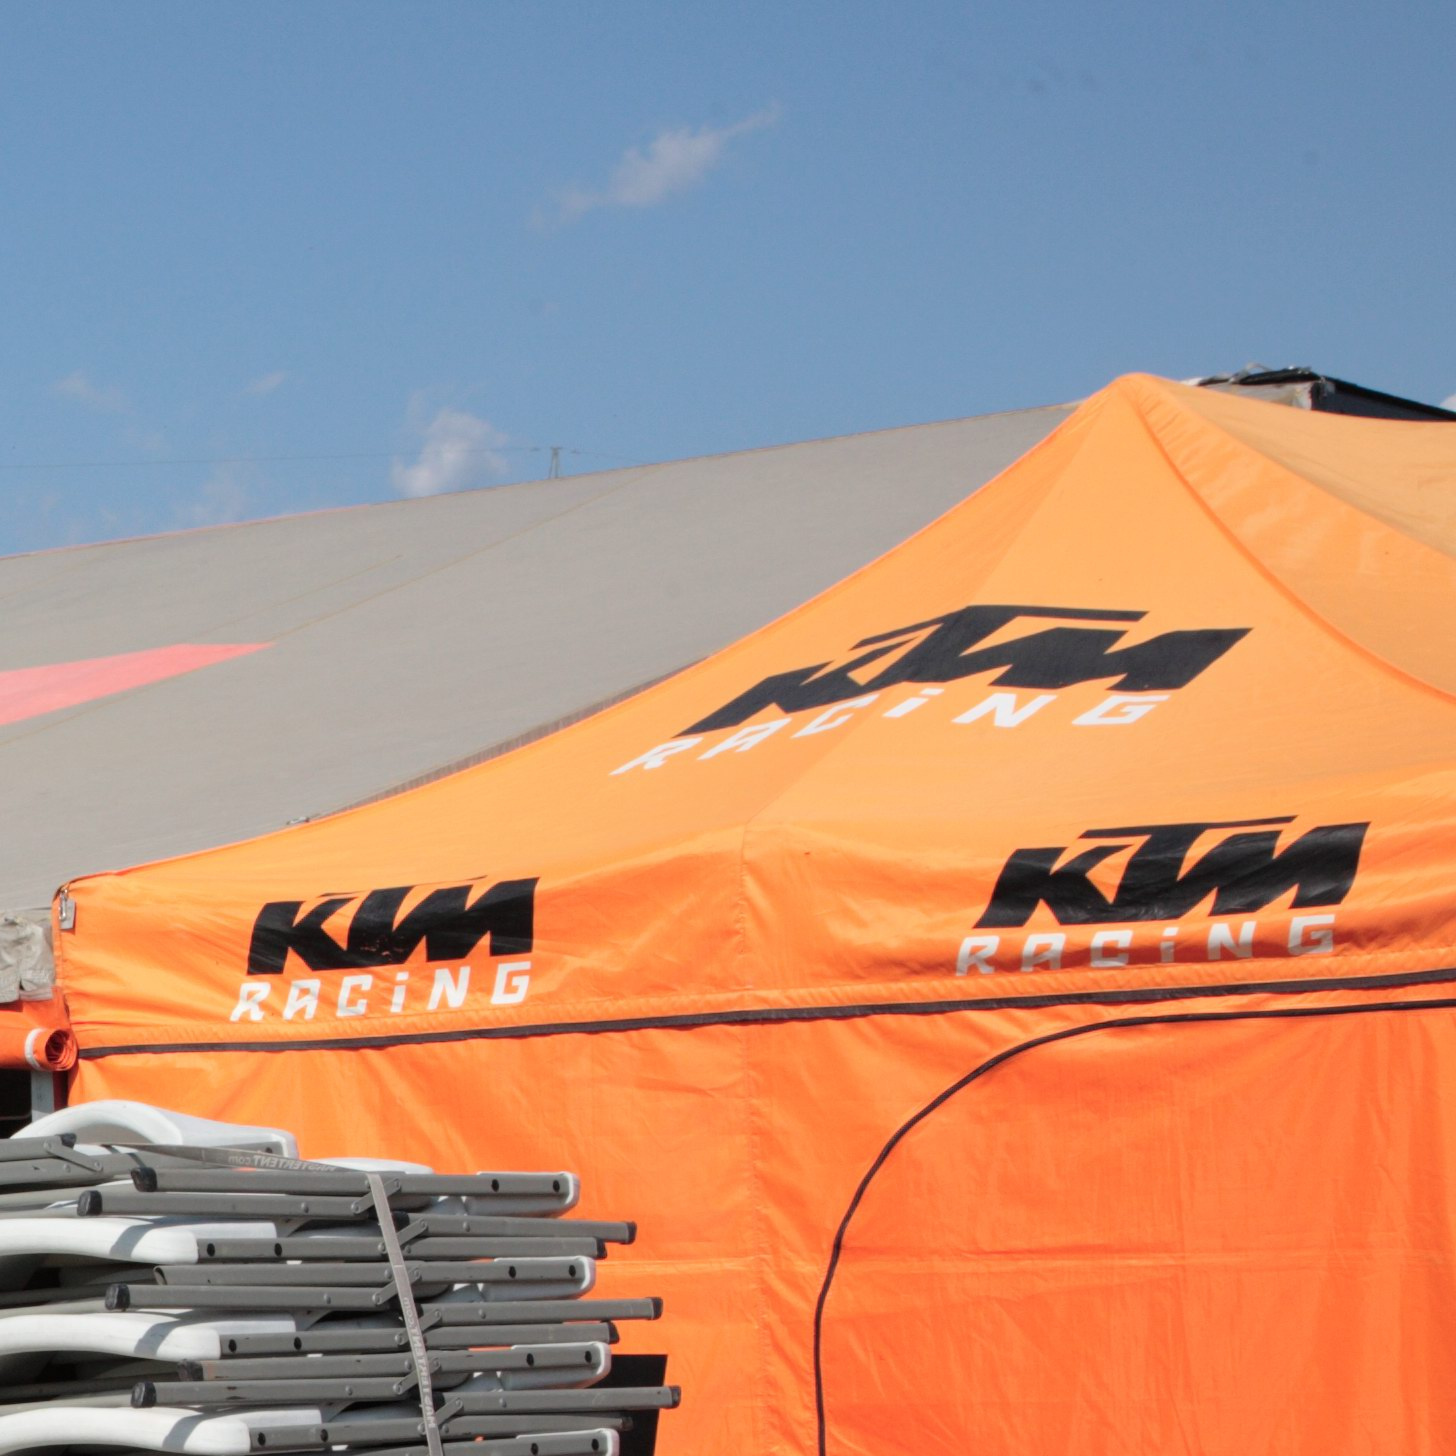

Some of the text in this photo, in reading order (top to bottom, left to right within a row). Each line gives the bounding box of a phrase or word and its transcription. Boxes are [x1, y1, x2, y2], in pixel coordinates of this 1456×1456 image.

[672, 604, 1253, 738] KTM
[247, 874, 541, 976] KTM
[973, 815, 1372, 929] KTM
